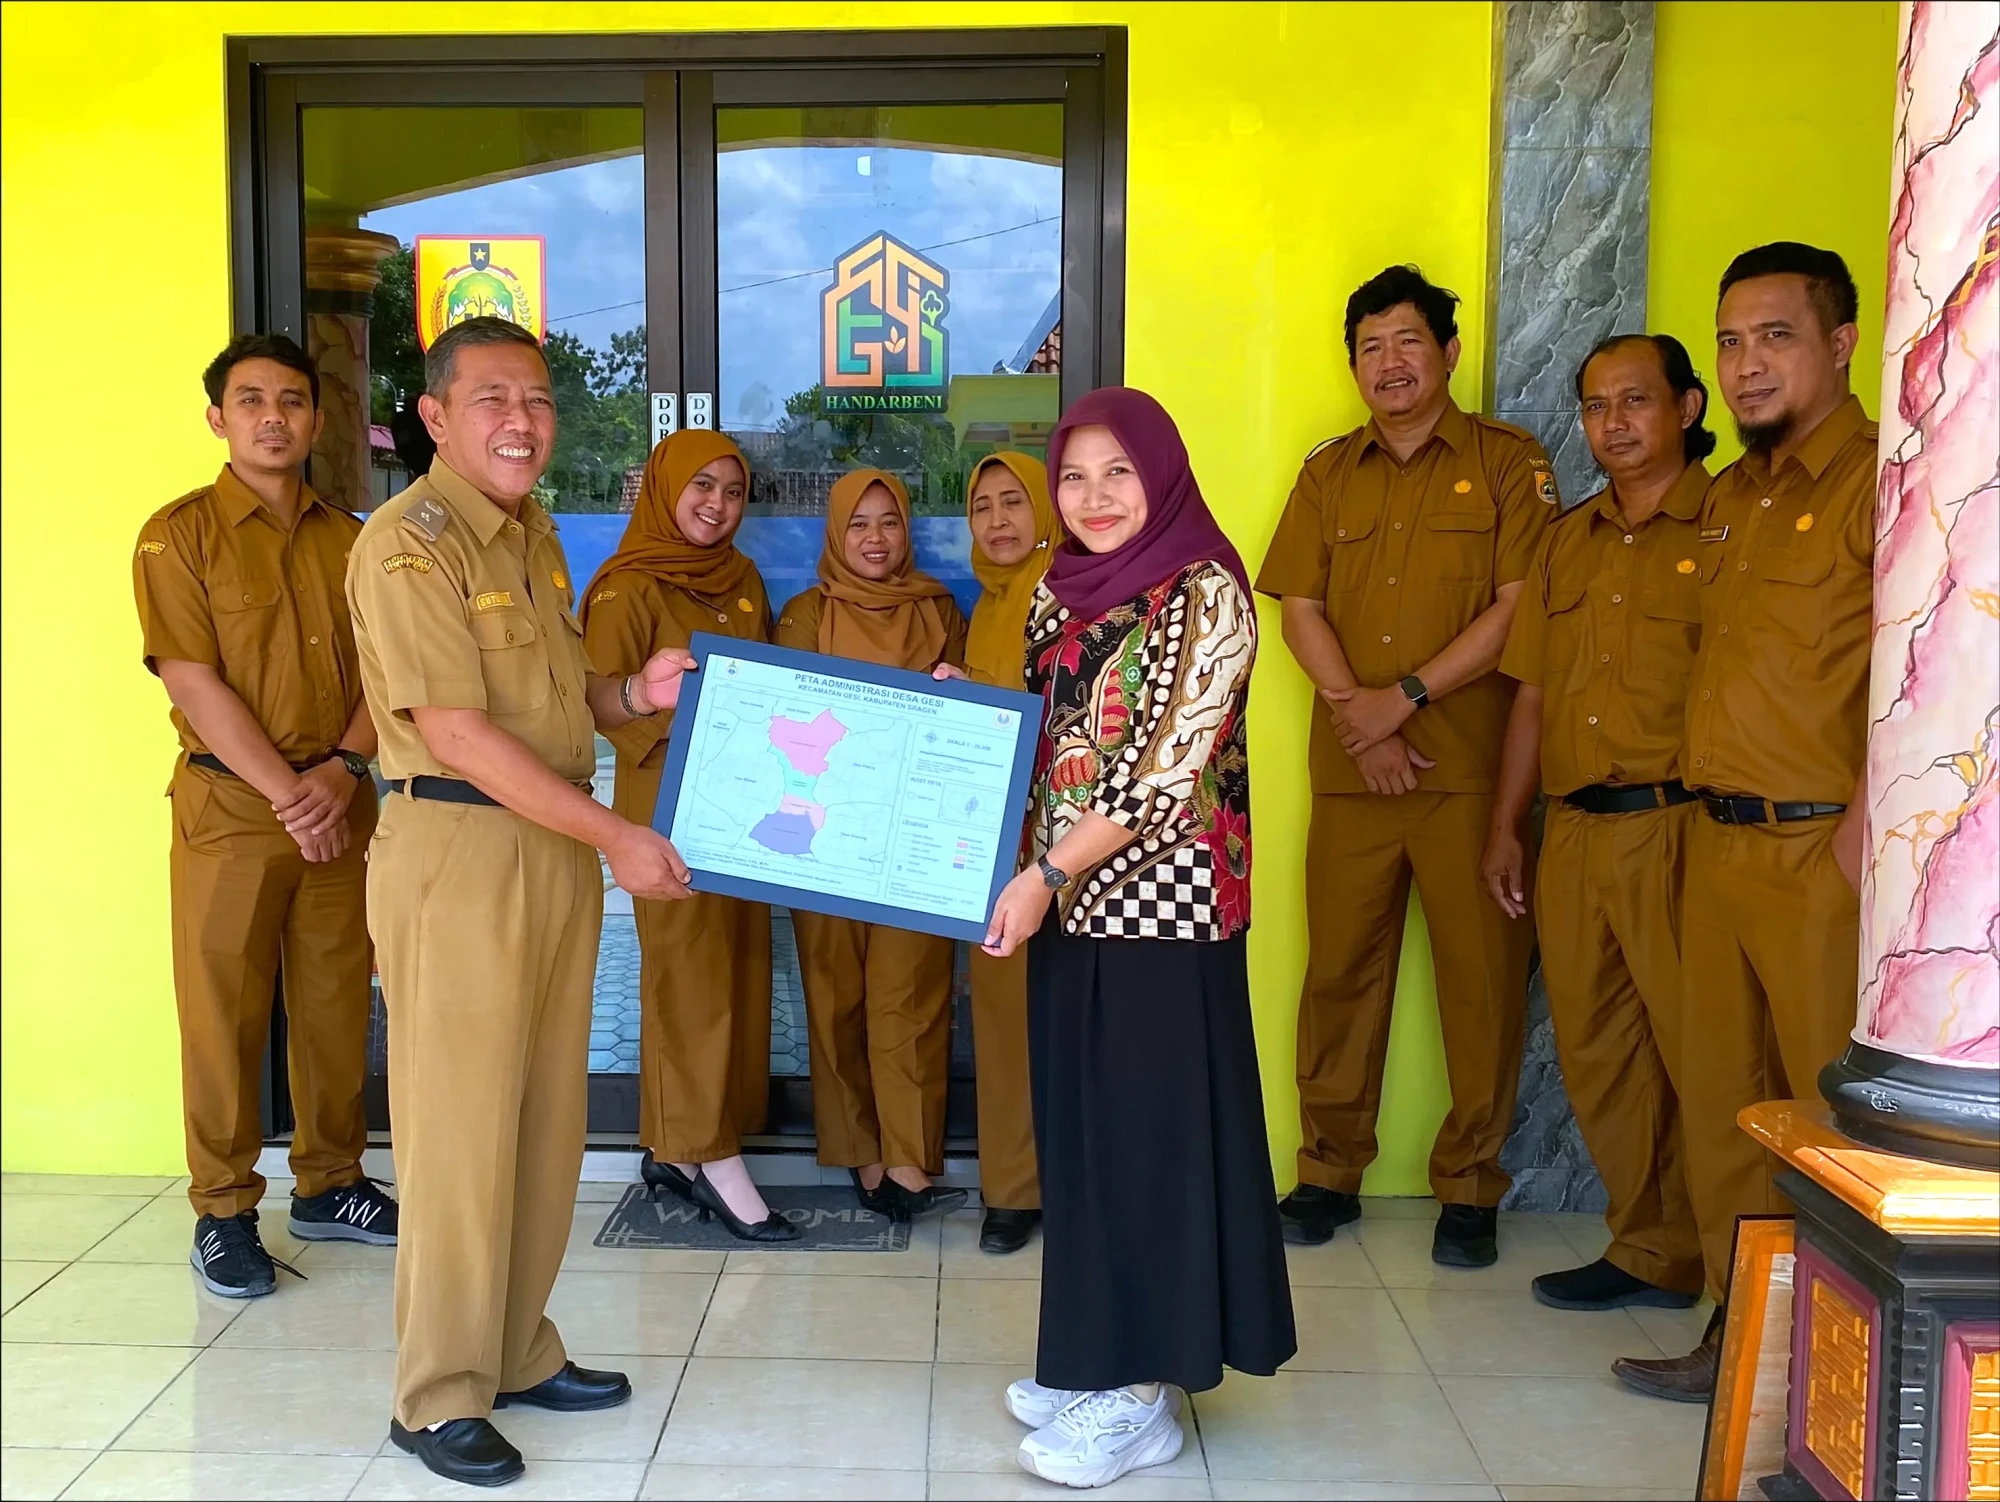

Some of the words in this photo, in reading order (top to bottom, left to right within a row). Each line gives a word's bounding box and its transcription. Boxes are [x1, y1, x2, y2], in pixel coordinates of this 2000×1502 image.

[826, 395, 942, 409] HANDARBENI
[794, 673, 819, 684] PETA
[820, 678, 890, 697] ADMINISTRASI
[892, 691, 919, 702] DESA
[921, 696, 944, 707] GESI
[798, 684, 841, 696] KECAMATAN
[863, 696, 905, 708] KABUPATEN
[907, 704, 937, 714] SRAGEN
[653, 1202, 875, 1228] WOME
